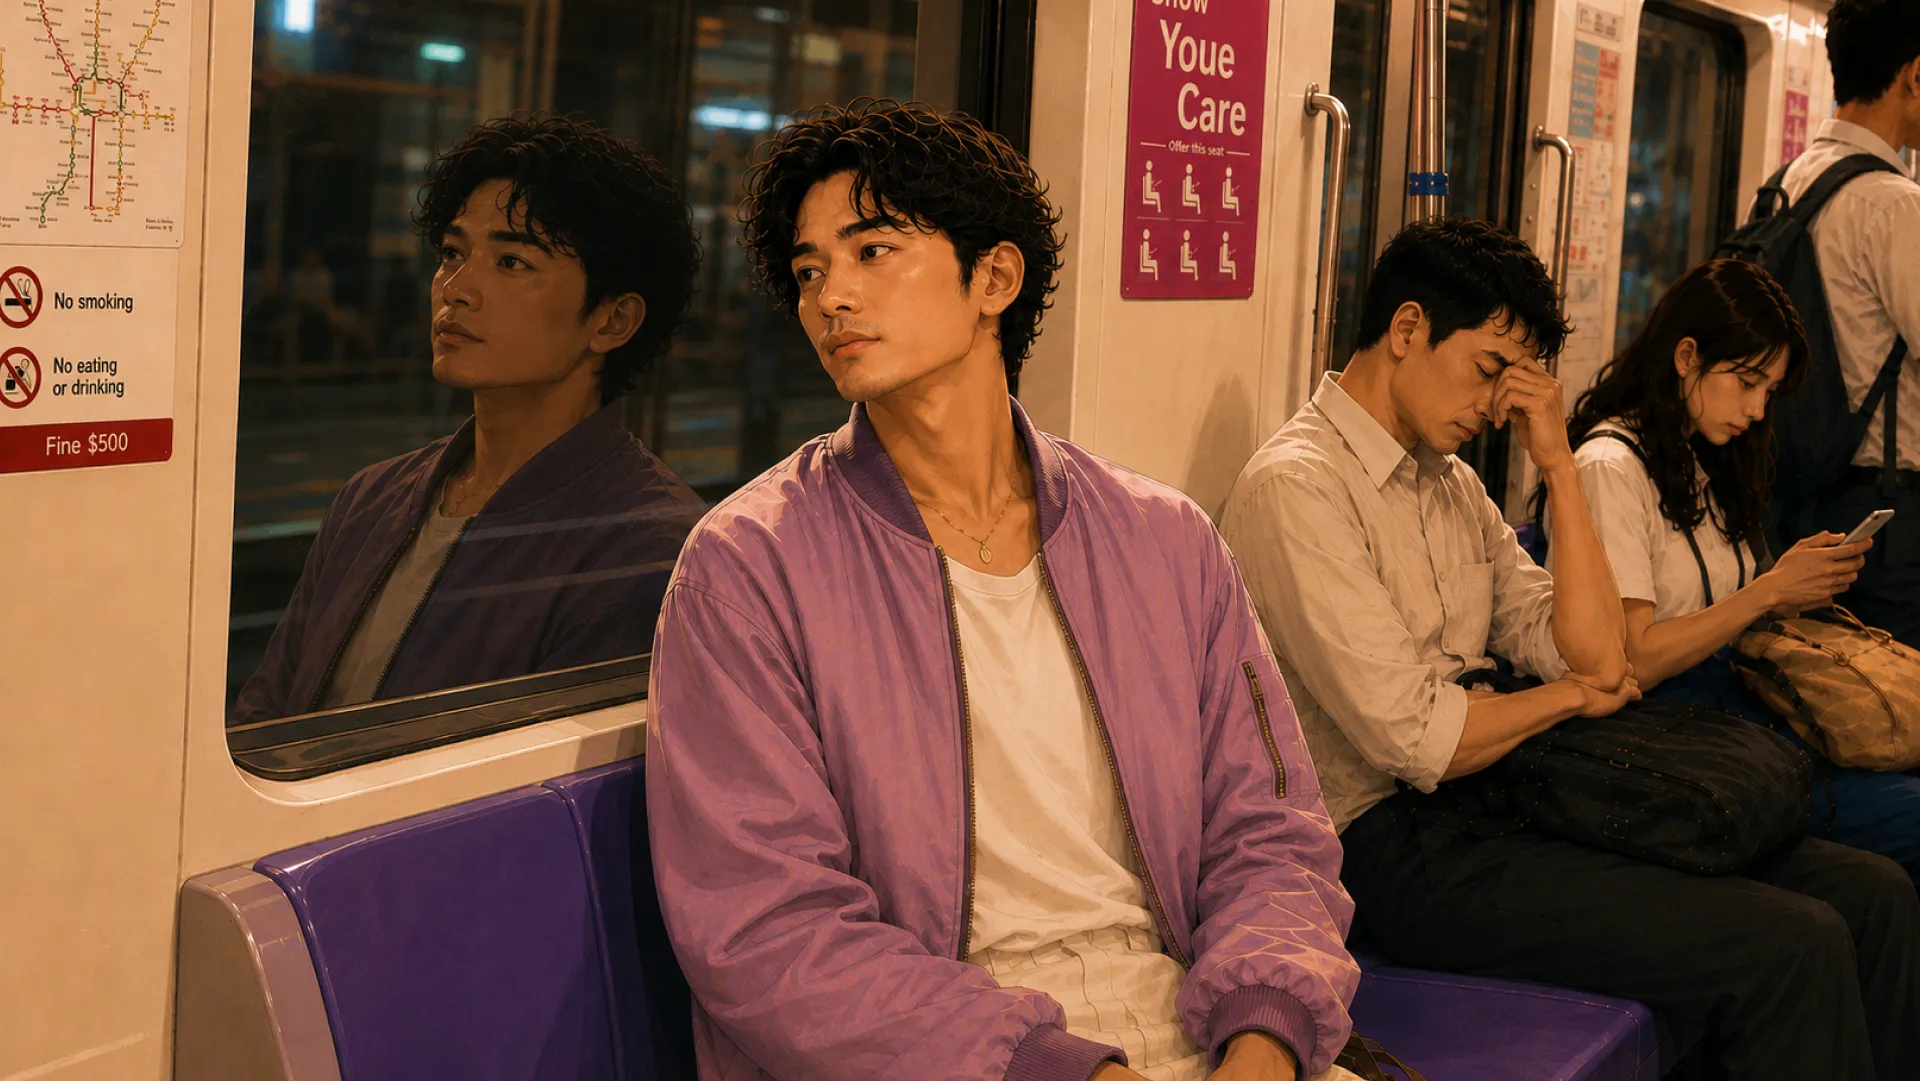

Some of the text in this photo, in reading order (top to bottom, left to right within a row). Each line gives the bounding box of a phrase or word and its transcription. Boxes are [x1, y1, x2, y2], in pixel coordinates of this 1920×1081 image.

[1160, 19, 1235, 79] Youe
[1178, 82, 1247, 136] Care
[1168, 140, 1224, 157] Offer this seat
[54, 291, 134, 313] No smoking
[53, 356, 118, 377] No eating
[52, 378, 125, 398] or drinking
[46, 431, 129, 456] Fine $500
